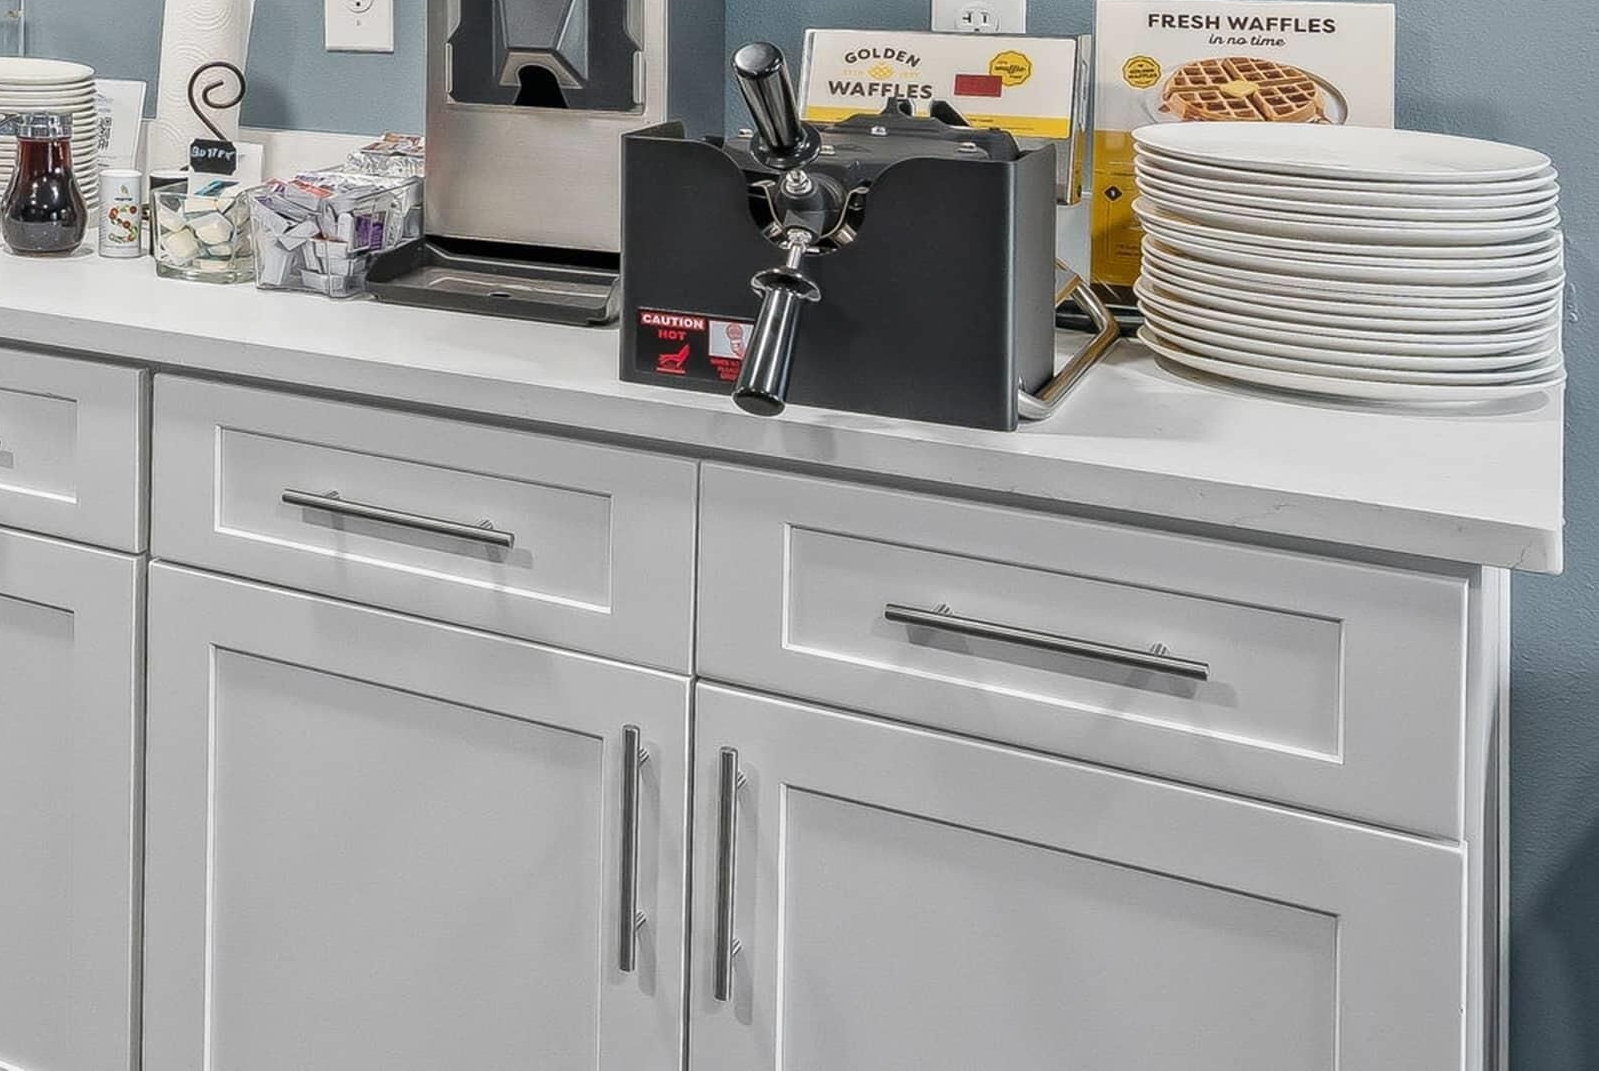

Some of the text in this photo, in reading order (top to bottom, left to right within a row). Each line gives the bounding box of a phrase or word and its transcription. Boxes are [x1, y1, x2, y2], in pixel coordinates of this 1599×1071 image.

[1148, 13, 1336, 34] FRESH WAFFLES
[1208, 33, 1287, 48] in no time
[844, 47, 921, 68] GOLDEN
[828, 80, 933, 100] WAFFLES
[642, 314, 704, 329] CAUTION
[658, 330, 687, 341] HOT
